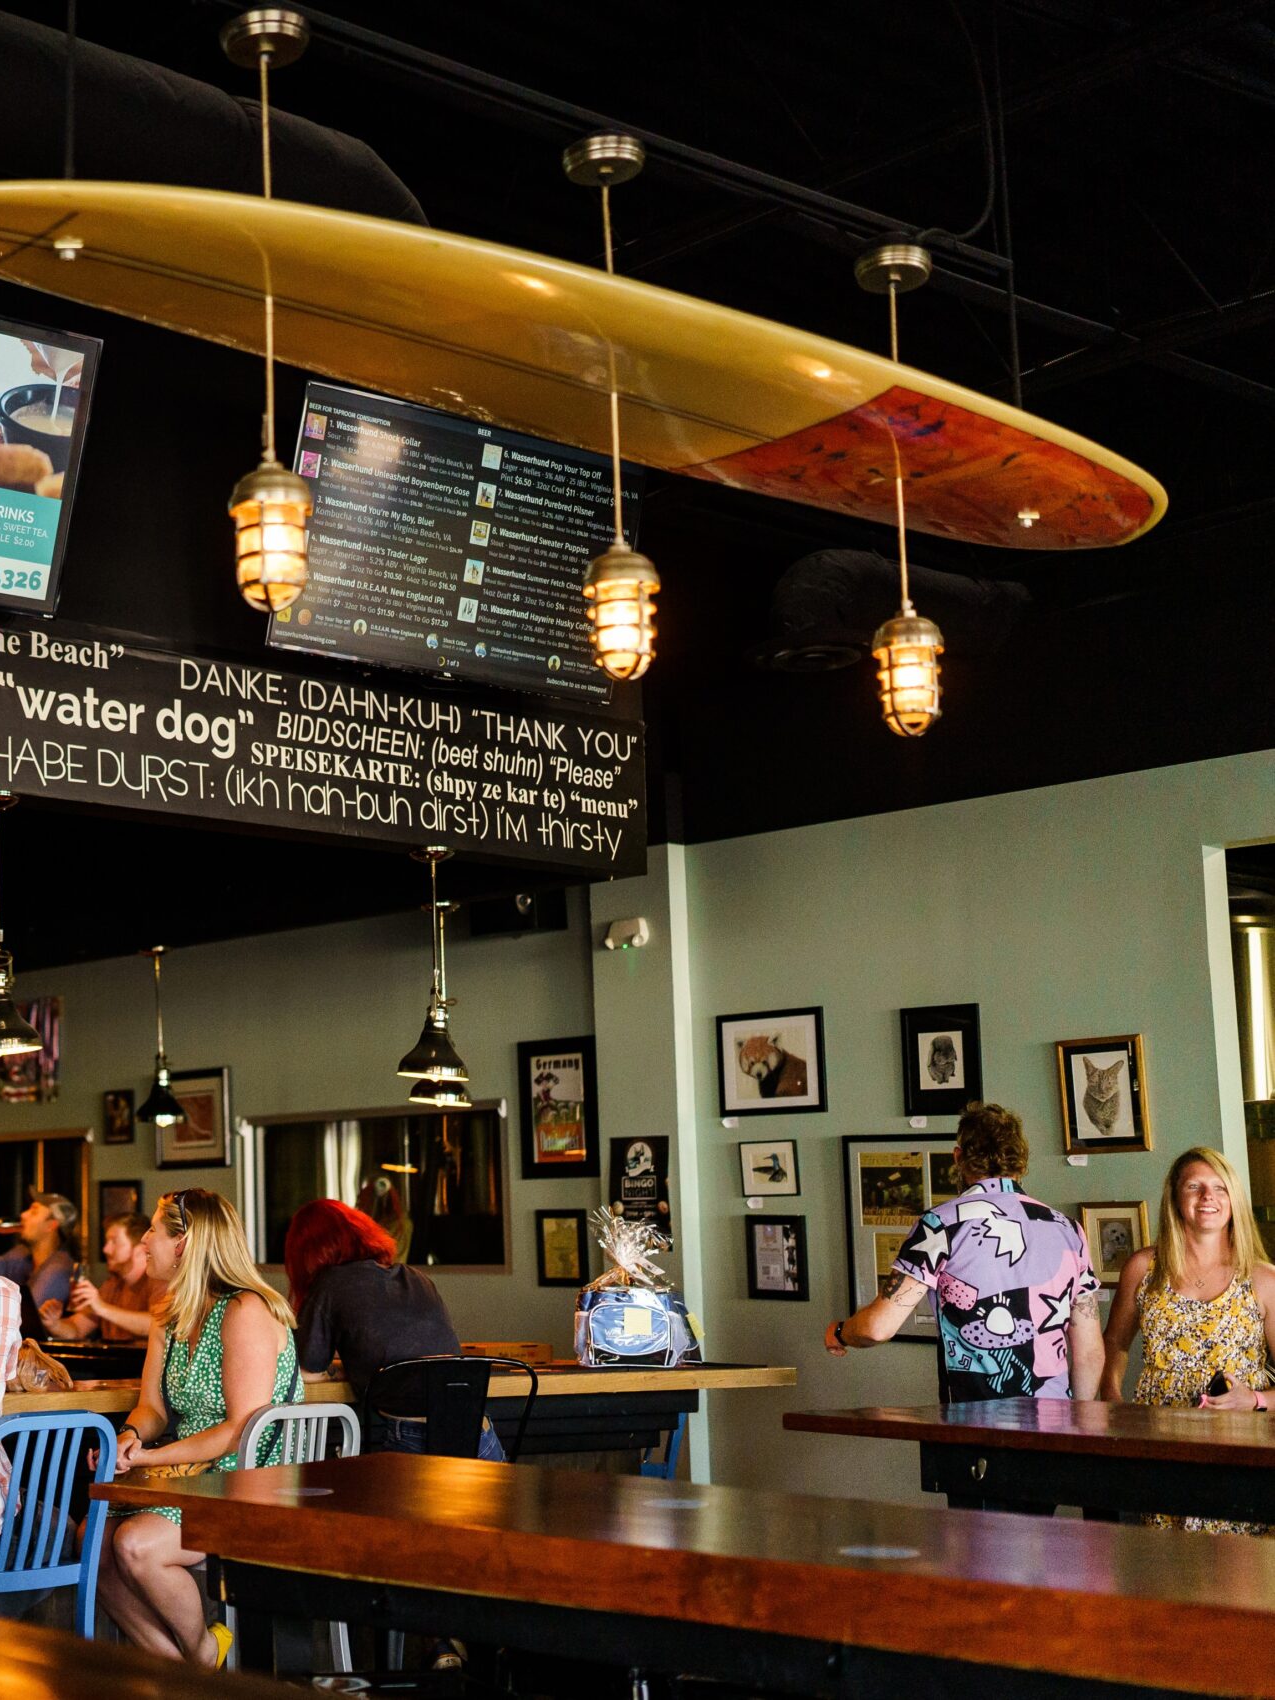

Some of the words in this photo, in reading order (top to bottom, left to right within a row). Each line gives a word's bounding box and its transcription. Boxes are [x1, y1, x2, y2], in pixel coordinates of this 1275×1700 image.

[336, 420, 378, 438] Wasserhund
[379, 431, 401, 444] Shock
[401, 436, 422, 448] Collar
[477, 427, 492, 438] BEER
[322, 457, 329, 467] 2.
[330, 458, 373, 476] Wasserhund
[374, 468, 410, 484] Unleashed
[411, 476, 453, 494] Boysenberry
[453, 486, 471, 498] Gose
[503, 450, 510, 459] 6.
[511, 451, 550, 468] Wasserhund
[550, 461, 563, 472] Pop
[564, 464, 578, 475] Your
[579, 468, 591, 479] Top
[591, 471, 602, 480] Off
[317, 495, 323, 504] 3.
[324, 496, 368, 513] Wasserhund
[368, 505, 390, 518] You’re
[390, 510, 401, 521] My
[417, 516, 435, 527] Blue!
[497, 488, 504, 497] 7.
[504, 489, 544, 506] Wasserhund
[544, 498, 573, 512] Purebred
[573, 505, 595, 518] Pilsner
[2, 521, 31, 536] SWEET
[13, 536, 35, 548] $2.00
[491, 526, 498, 535] 8.
[499, 527, 538, 544] Wasserhund
[538, 535, 564, 549] Sweater
[564, 542, 590, 555] Puppies
[319, 534, 362, 551] Wasserhund
[362, 543, 386, 555] Hank’s
[387, 548, 409, 561] Trader
[409, 553, 429, 565] Lager
[28, 631, 126, 671] Beach”
[179, 658, 289, 706] DANKE:
[299, 678, 462, 735] (DAHN-KUH)
[471, 709, 568, 754] “THANK
[577, 727, 638, 763] YOU”
[155, 698, 255, 760] dog”
[276, 711, 427, 761] BIDDSCHEEN:
[430, 736, 478, 770] (beet
[483, 746, 545, 785] shuhn)
[549, 757, 623, 791] “Please”
[250, 741, 421, 789] SPEISEKARTE:
[426, 768, 477, 804] (shpy
[482, 782, 502, 802] ze
[506, 779, 538, 808] kar
[542, 788, 567, 815] te)
[570, 791, 639, 820] “menu”
[97, 748, 217, 803] DURST:
[224, 764, 281, 809] (ikh
[288, 774, 413, 828] hah-buh
[419, 794, 490, 841] dirst)
[537, 812, 623, 861] thirsty
[535, 1057, 581, 1071] Germany
[624, 1178, 654, 1188] BINGO
